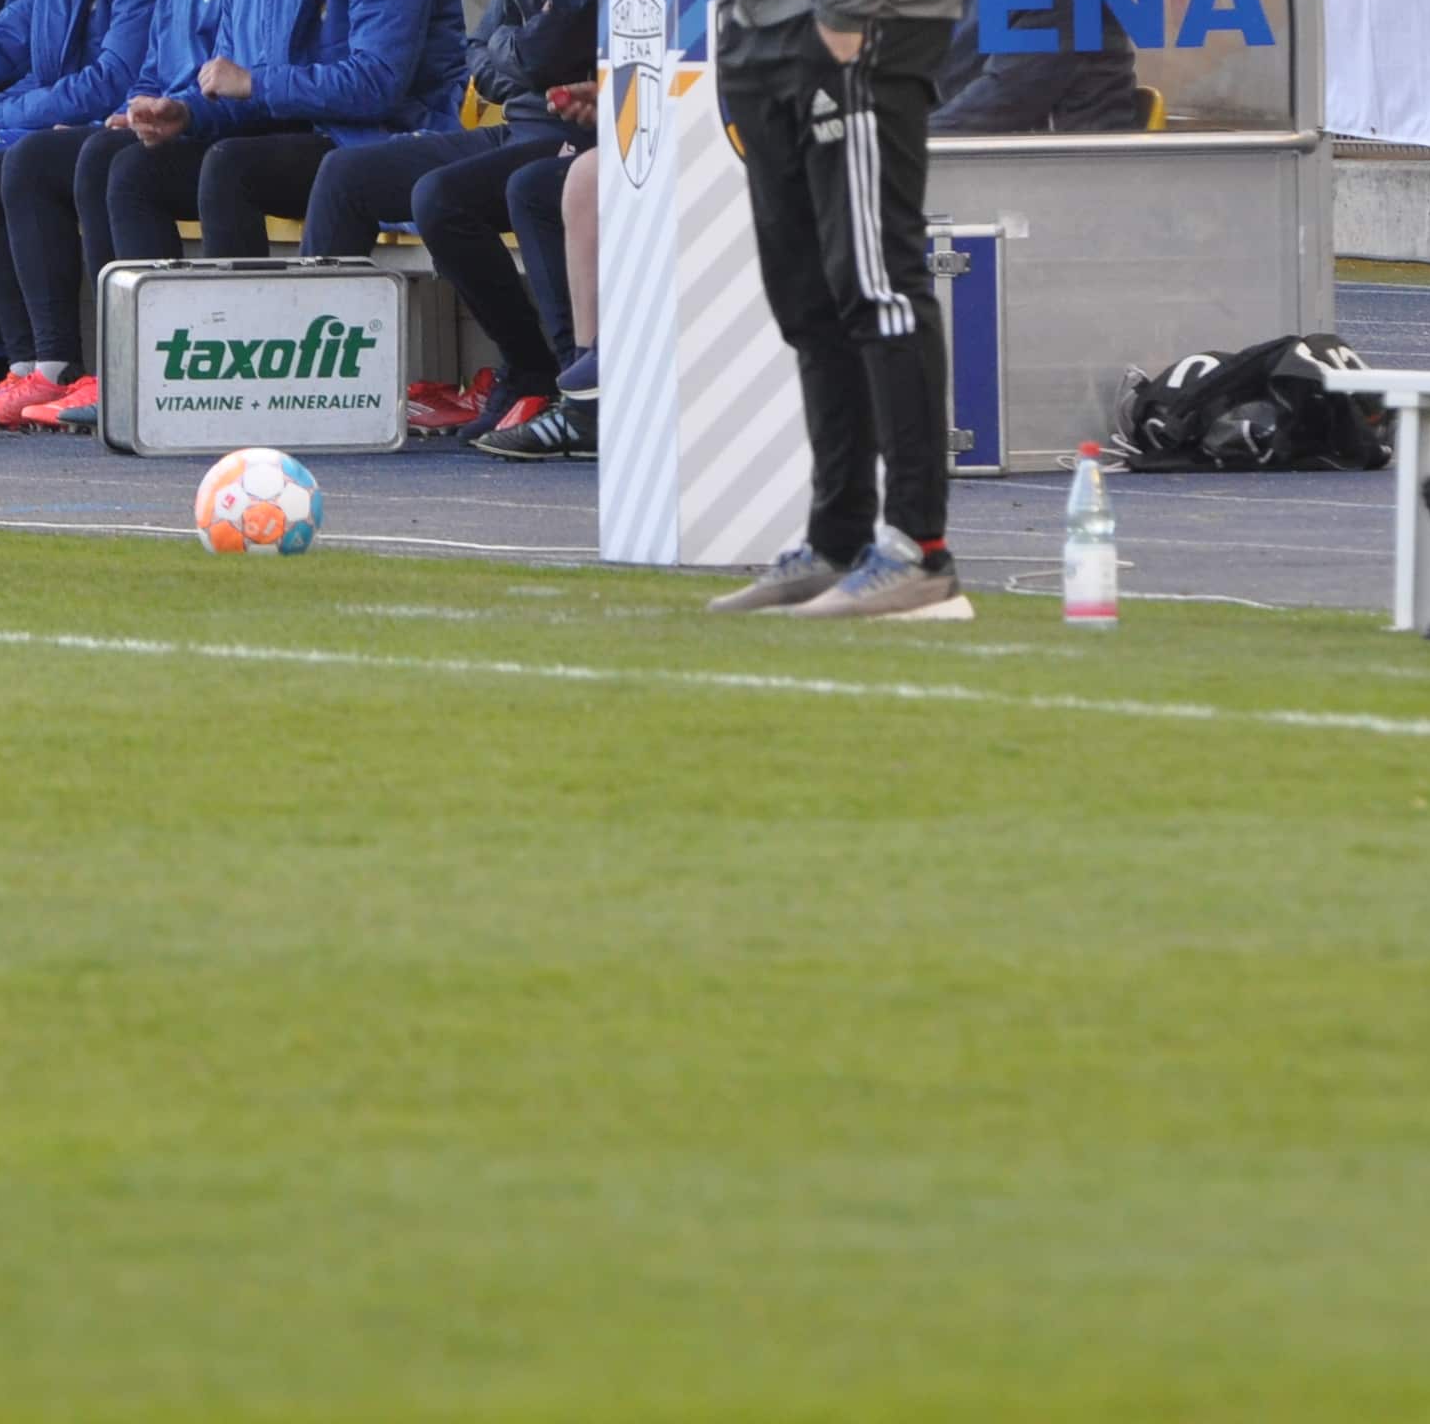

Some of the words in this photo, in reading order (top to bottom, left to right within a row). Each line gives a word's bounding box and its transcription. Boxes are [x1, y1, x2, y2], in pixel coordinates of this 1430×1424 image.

[622, 40, 652, 61] JENA
[155, 314, 377, 381] taxofit
[155, 395, 244, 412] VITAMINE
[267, 393, 382, 410] MINERALIEN
